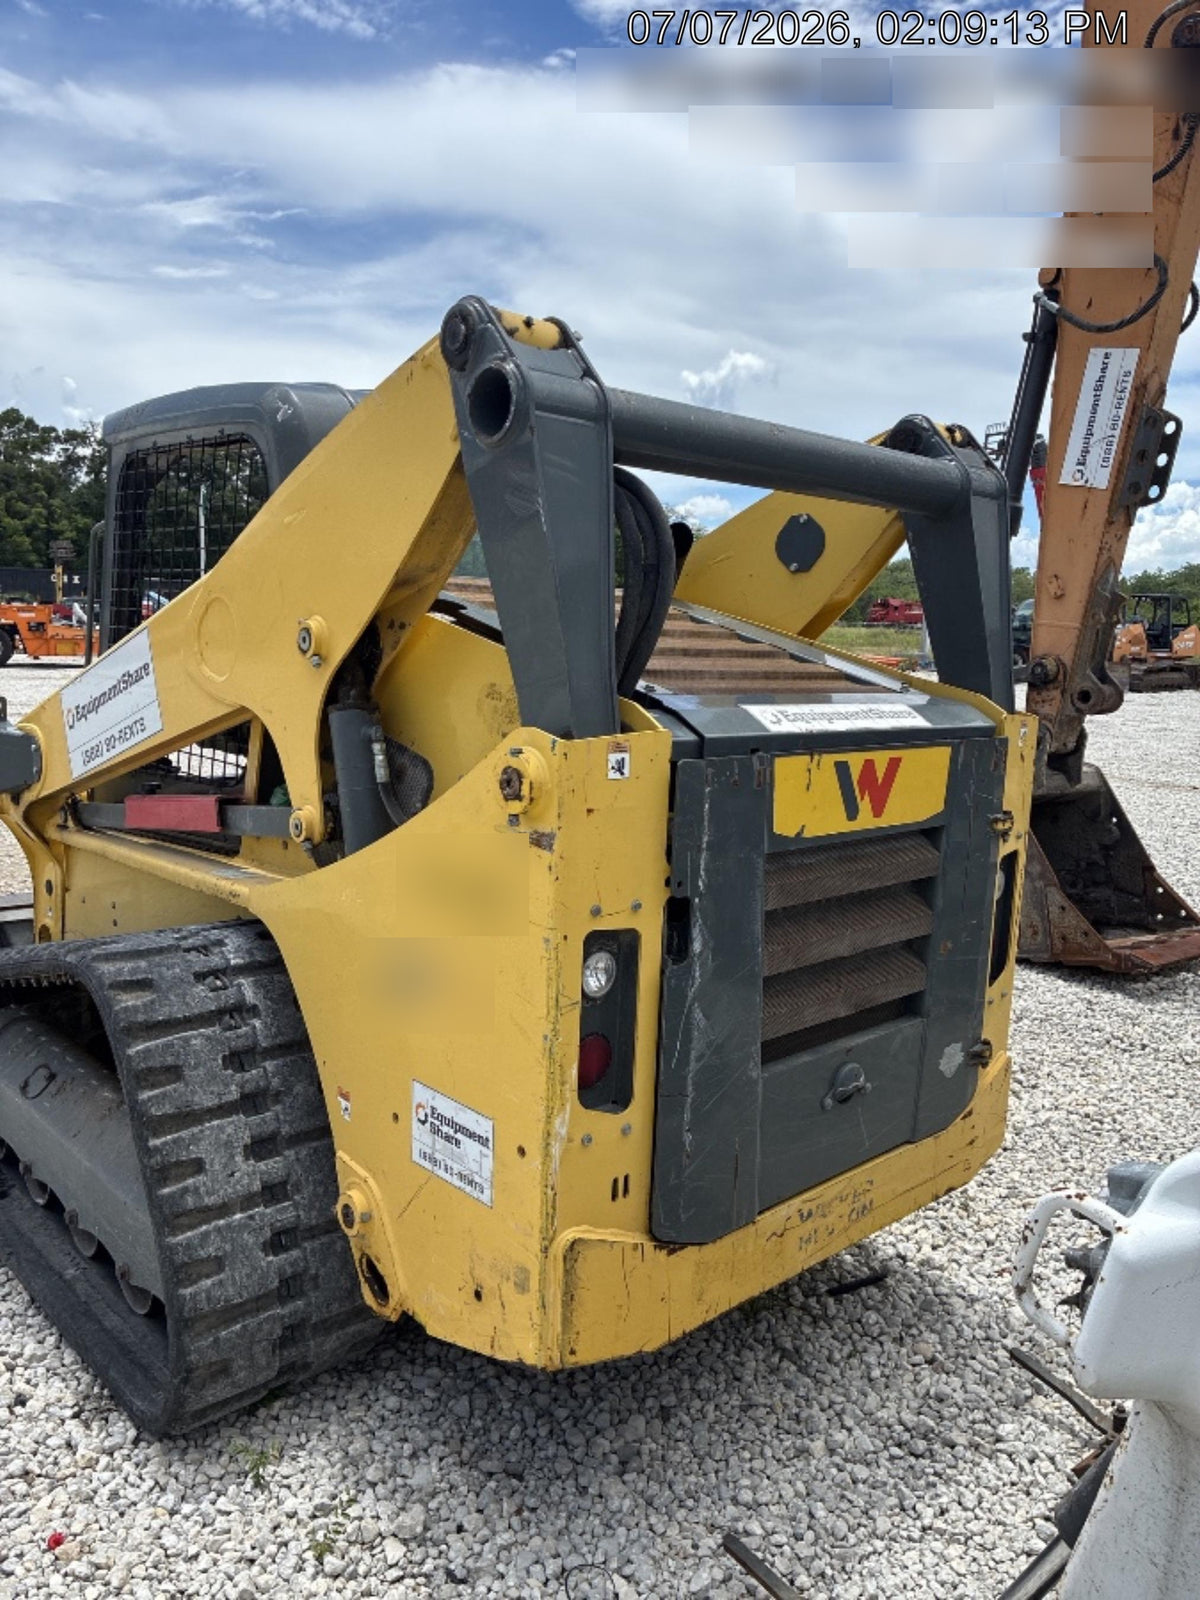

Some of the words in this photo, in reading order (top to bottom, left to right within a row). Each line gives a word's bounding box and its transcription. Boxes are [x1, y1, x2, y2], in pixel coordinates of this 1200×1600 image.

[74, 662, 150, 723] EquipmentShare
[429, 1121, 462, 1150] Share
[430, 1105, 491, 1150] Equipment
